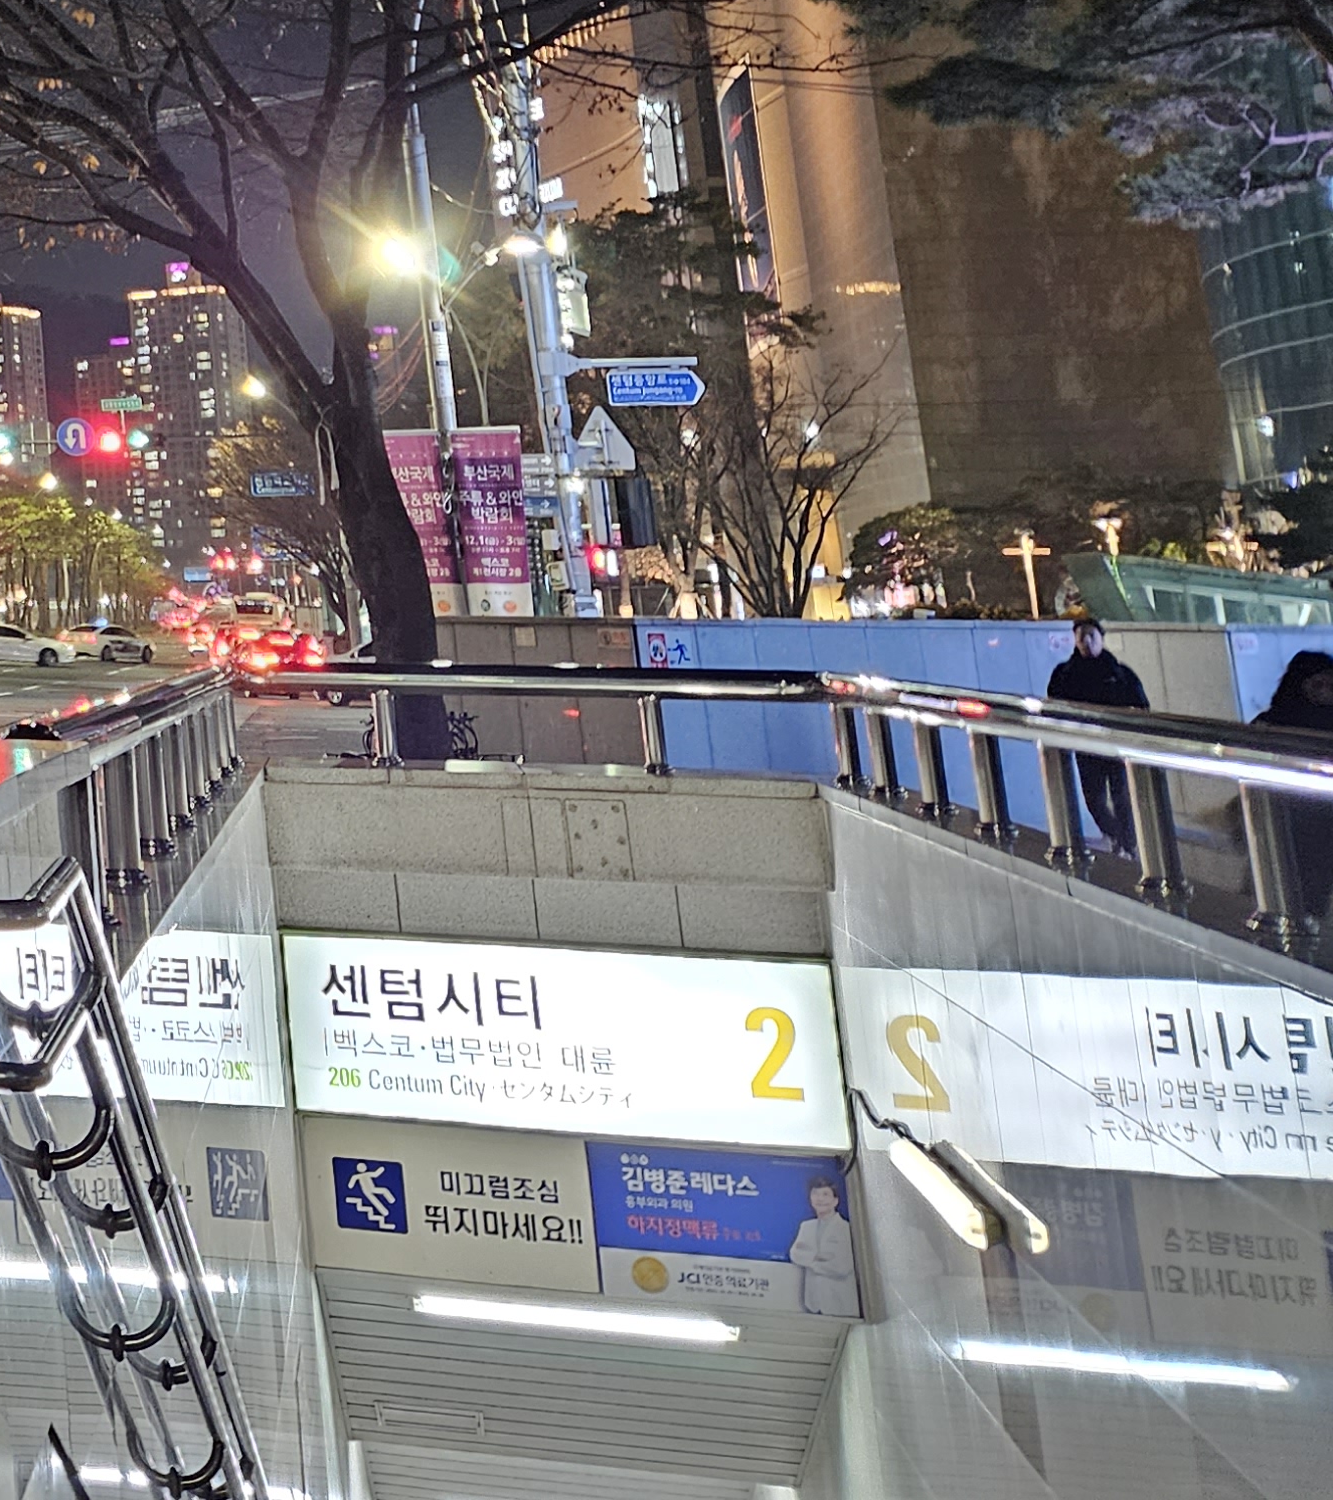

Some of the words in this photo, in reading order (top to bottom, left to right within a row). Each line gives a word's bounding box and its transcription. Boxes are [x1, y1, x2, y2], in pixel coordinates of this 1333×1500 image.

[463, 463, 515, 482] 부산국제
[459, 490, 484, 506] 주류
[486, 491, 497, 505] &
[499, 490, 523, 506] 와인
[471, 506, 513, 524] 박람회
[321, 964, 542, 1031] 센텀시티
[561, 1045, 617, 1076] 대륜
[744, 1006, 805, 1102] 2
[328, 1067, 362, 1088] 206
[369, 1069, 444, 1096] Centum
[450, 1075, 485, 1103] City
[439, 1170, 560, 1204] 미끄럼조심
[621, 1166, 760, 1197] 김병준레다스
[670, 1197, 694, 1212] 의원
[424, 1204, 584, 1246] 뛰지마세요!!
[626, 1214, 720, 1241] 하지정맥류
[677, 1271, 700, 1285] JCI
[702, 1272, 724, 1288] 인증
